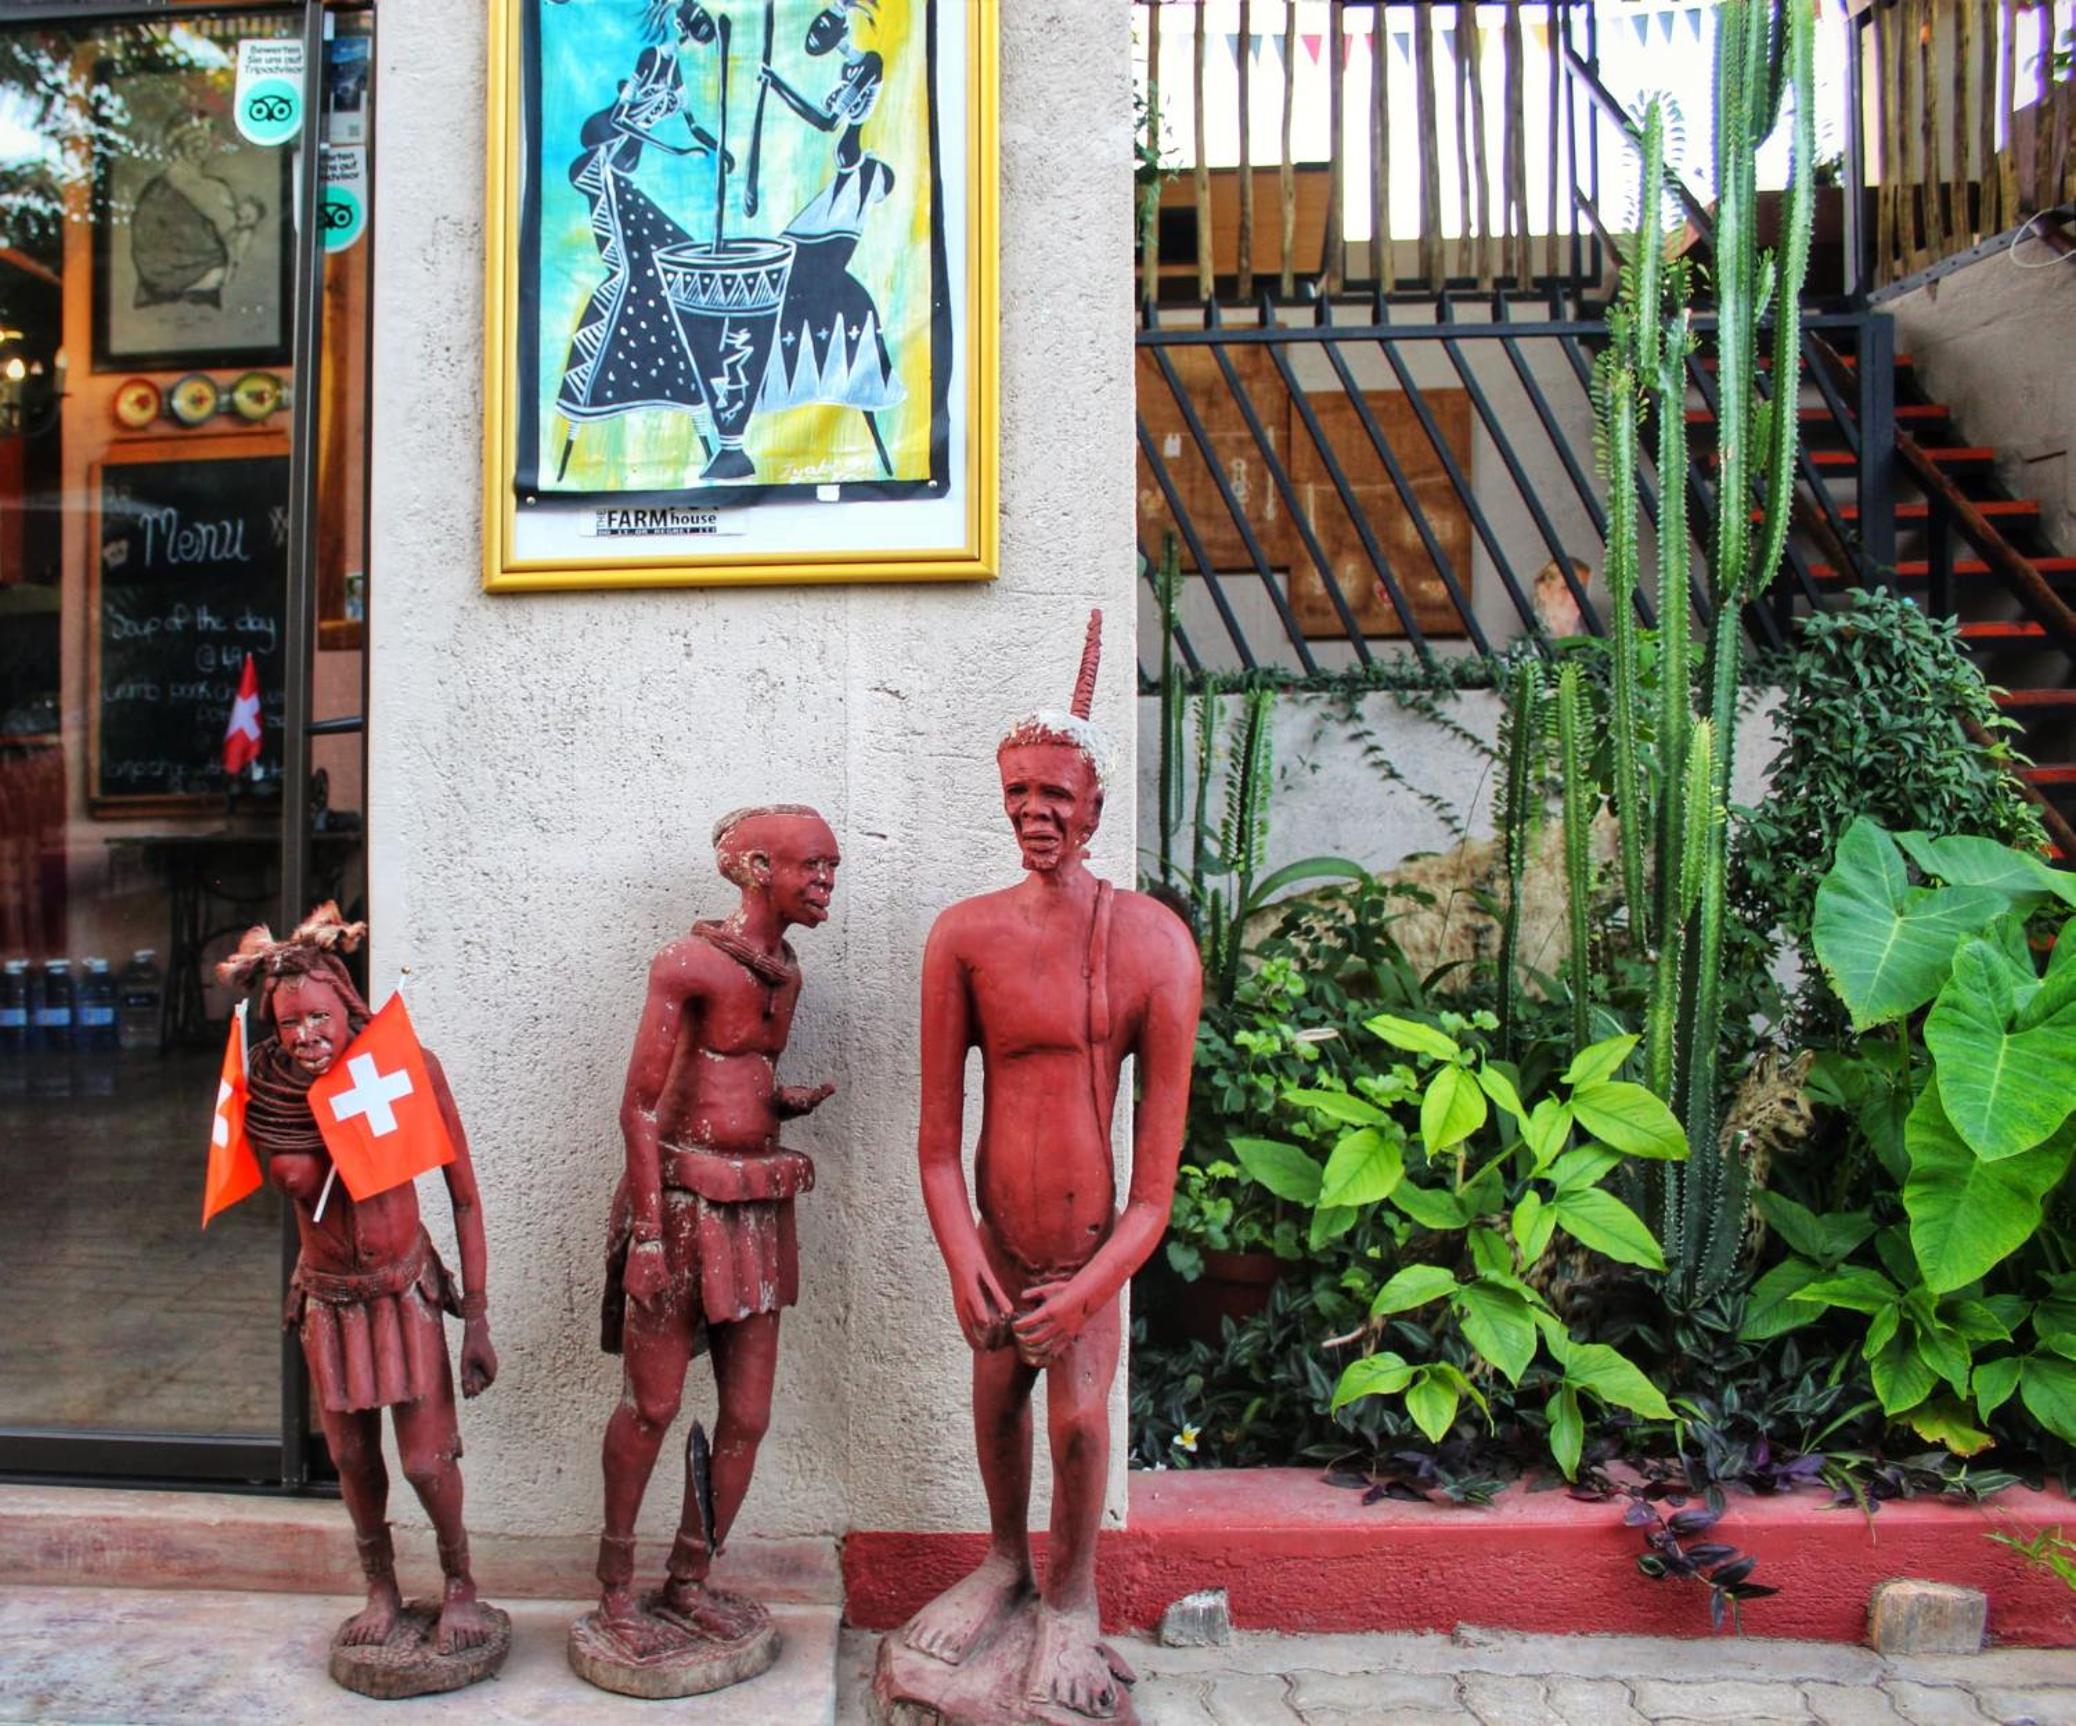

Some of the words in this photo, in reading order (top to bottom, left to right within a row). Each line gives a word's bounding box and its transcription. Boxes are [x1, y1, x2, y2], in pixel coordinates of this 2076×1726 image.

[245, 65, 305, 75] Tripadvisor
[138, 507, 251, 567] Menu
[196, 604, 229, 631] the
[235, 605, 276, 653] day
